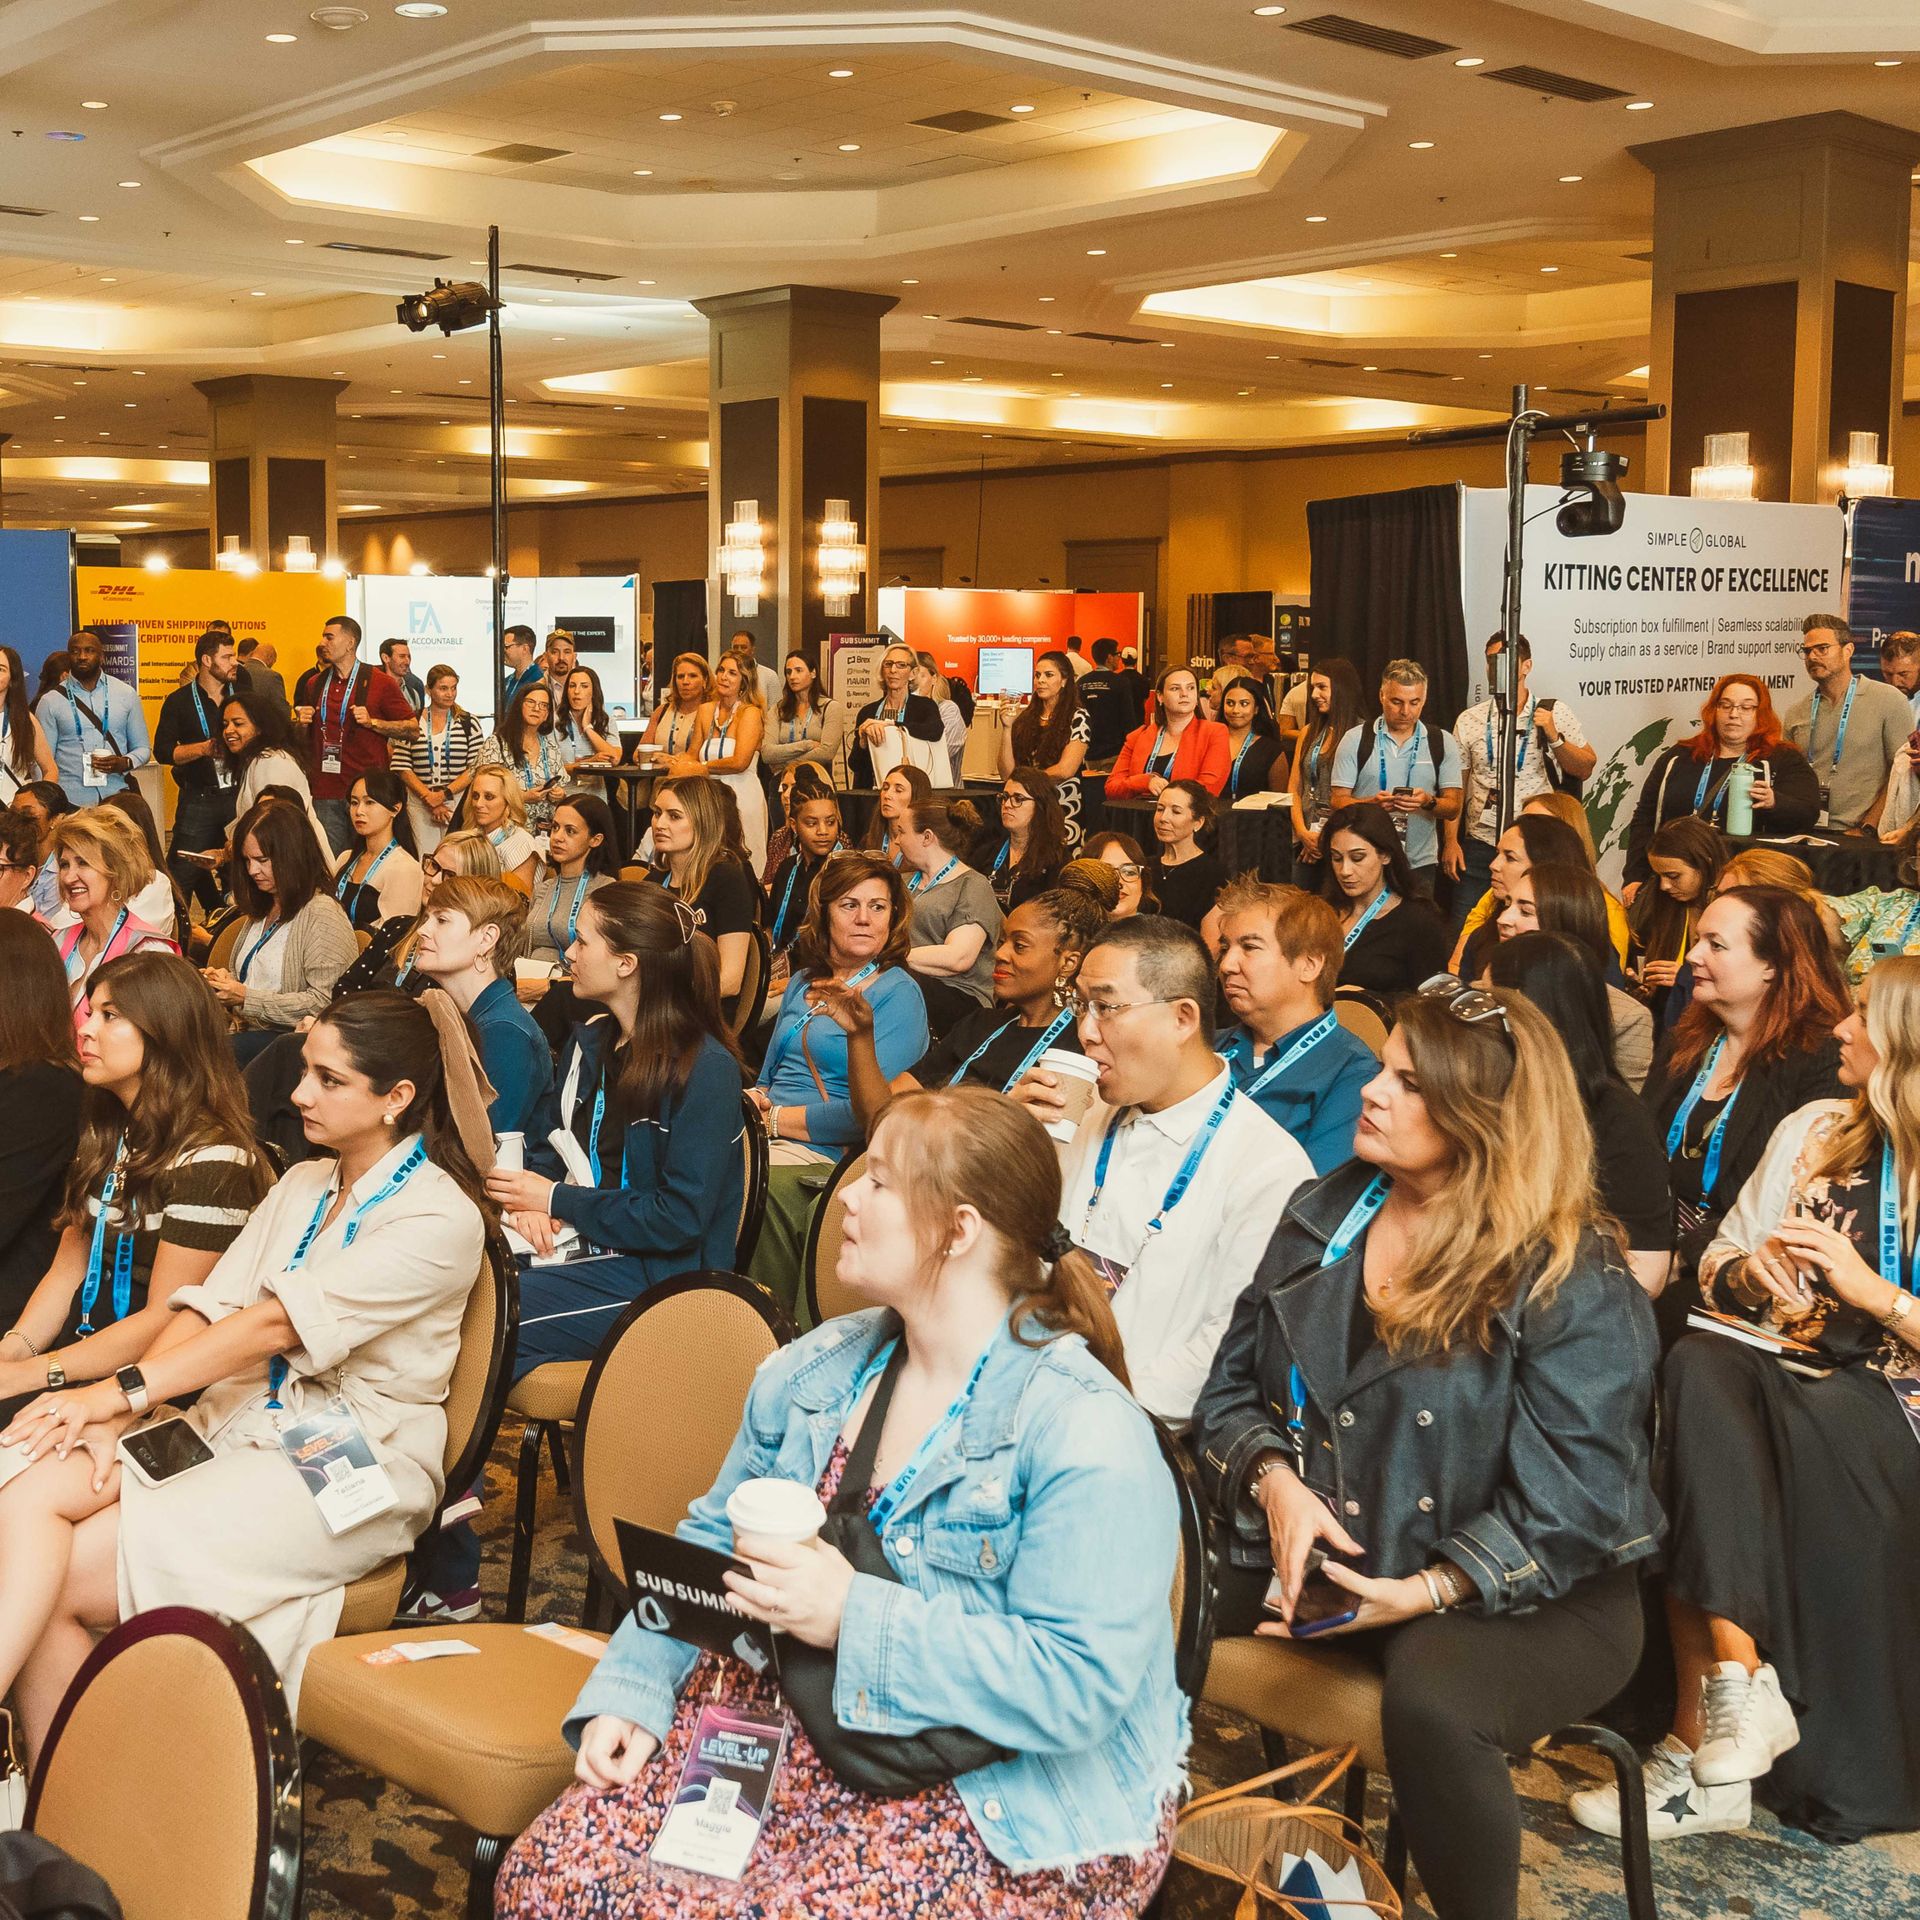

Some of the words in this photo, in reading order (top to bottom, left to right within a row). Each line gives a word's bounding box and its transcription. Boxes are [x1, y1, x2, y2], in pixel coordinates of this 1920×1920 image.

[1647, 532, 1688, 547] SIMPLE
[1705, 535, 1747, 549] GLOBAL
[1544, 563, 1622, 591] KITTING
[1626, 566, 1697, 592] CENTER
[1701, 567, 1724, 592] OF
[1728, 568, 1829, 593] EXCELLENCE
[98, 585, 136, 595] DHL
[1574, 617, 1638, 637] Subscription
[1641, 618, 1659, 634] box
[1662, 617, 1709, 633] fulfillment
[1718, 617, 1762, 632] Seamless
[1765, 617, 1804, 632] scalabilit
[138, 634, 186, 644] CRIPTION
[411, 637, 465, 645] ACCOUNTABLE
[101, 656, 135, 666] AWARDS
[856, 655, 871, 664] Brex
[1569, 642, 1605, 662] Supply
[1608, 641, 1637, 657] chain
[1639, 645, 1651, 656] as
[1654, 645, 1661, 656] a
[1663, 642, 1698, 656] service
[1708, 640, 1735, 655] Brand
[1737, 640, 1772, 658] support
[1578, 679, 1611, 697] YOUR
[1614, 677, 1665, 695] TRUSTED
[1667, 675, 1715, 693] PARTNER
[1042, 1020, 1065, 1043] BOLD
[1299, 1024, 1327, 1049] BOLD
[1207, 1110, 1221, 1127] SUB
[392, 1149, 424, 1183] BOLD
[1884, 1225, 1896, 1266] BOLD
[334, 1478, 366, 1495] Tatiana
[895, 1467, 917, 1493] SUB
[700, 1737, 770, 1763] LEVEL-UP
[695, 1816, 732, 1834] Maggie
